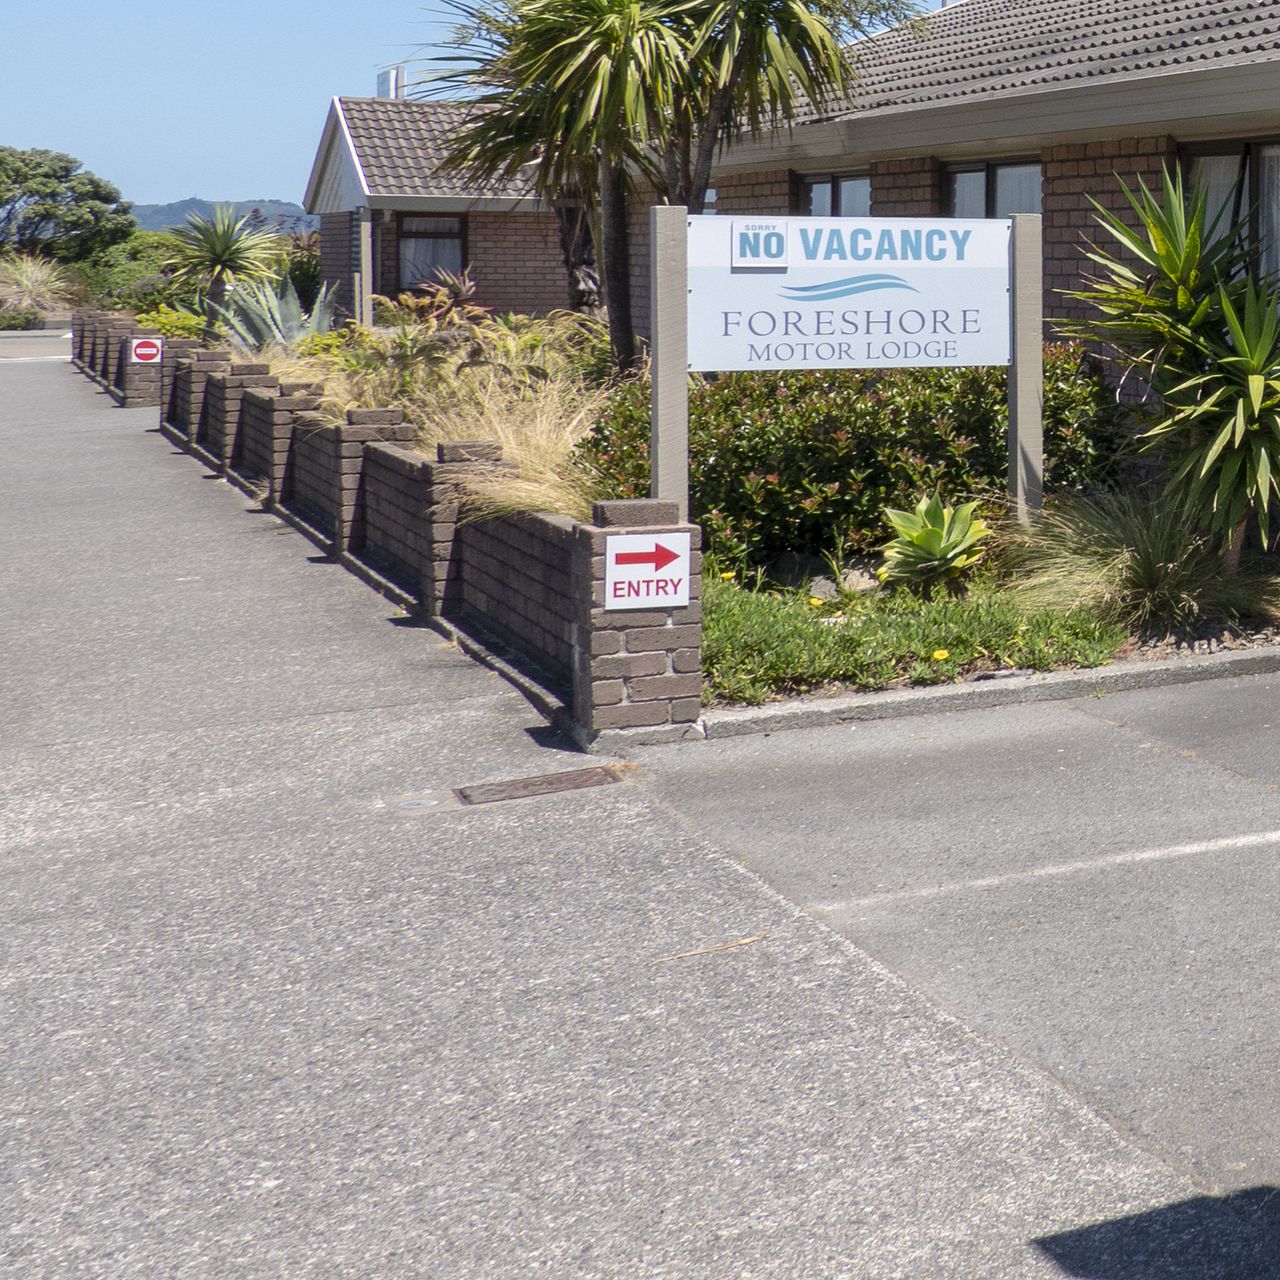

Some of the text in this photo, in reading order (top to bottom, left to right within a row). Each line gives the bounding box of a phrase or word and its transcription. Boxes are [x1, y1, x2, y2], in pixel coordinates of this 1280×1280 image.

[739, 228, 972, 261] NO VACANCY
[721, 309, 982, 337] FORESHORE
[747, 340, 958, 362] MOTOR LODGE
[613, 578, 683, 598] ENTRY
